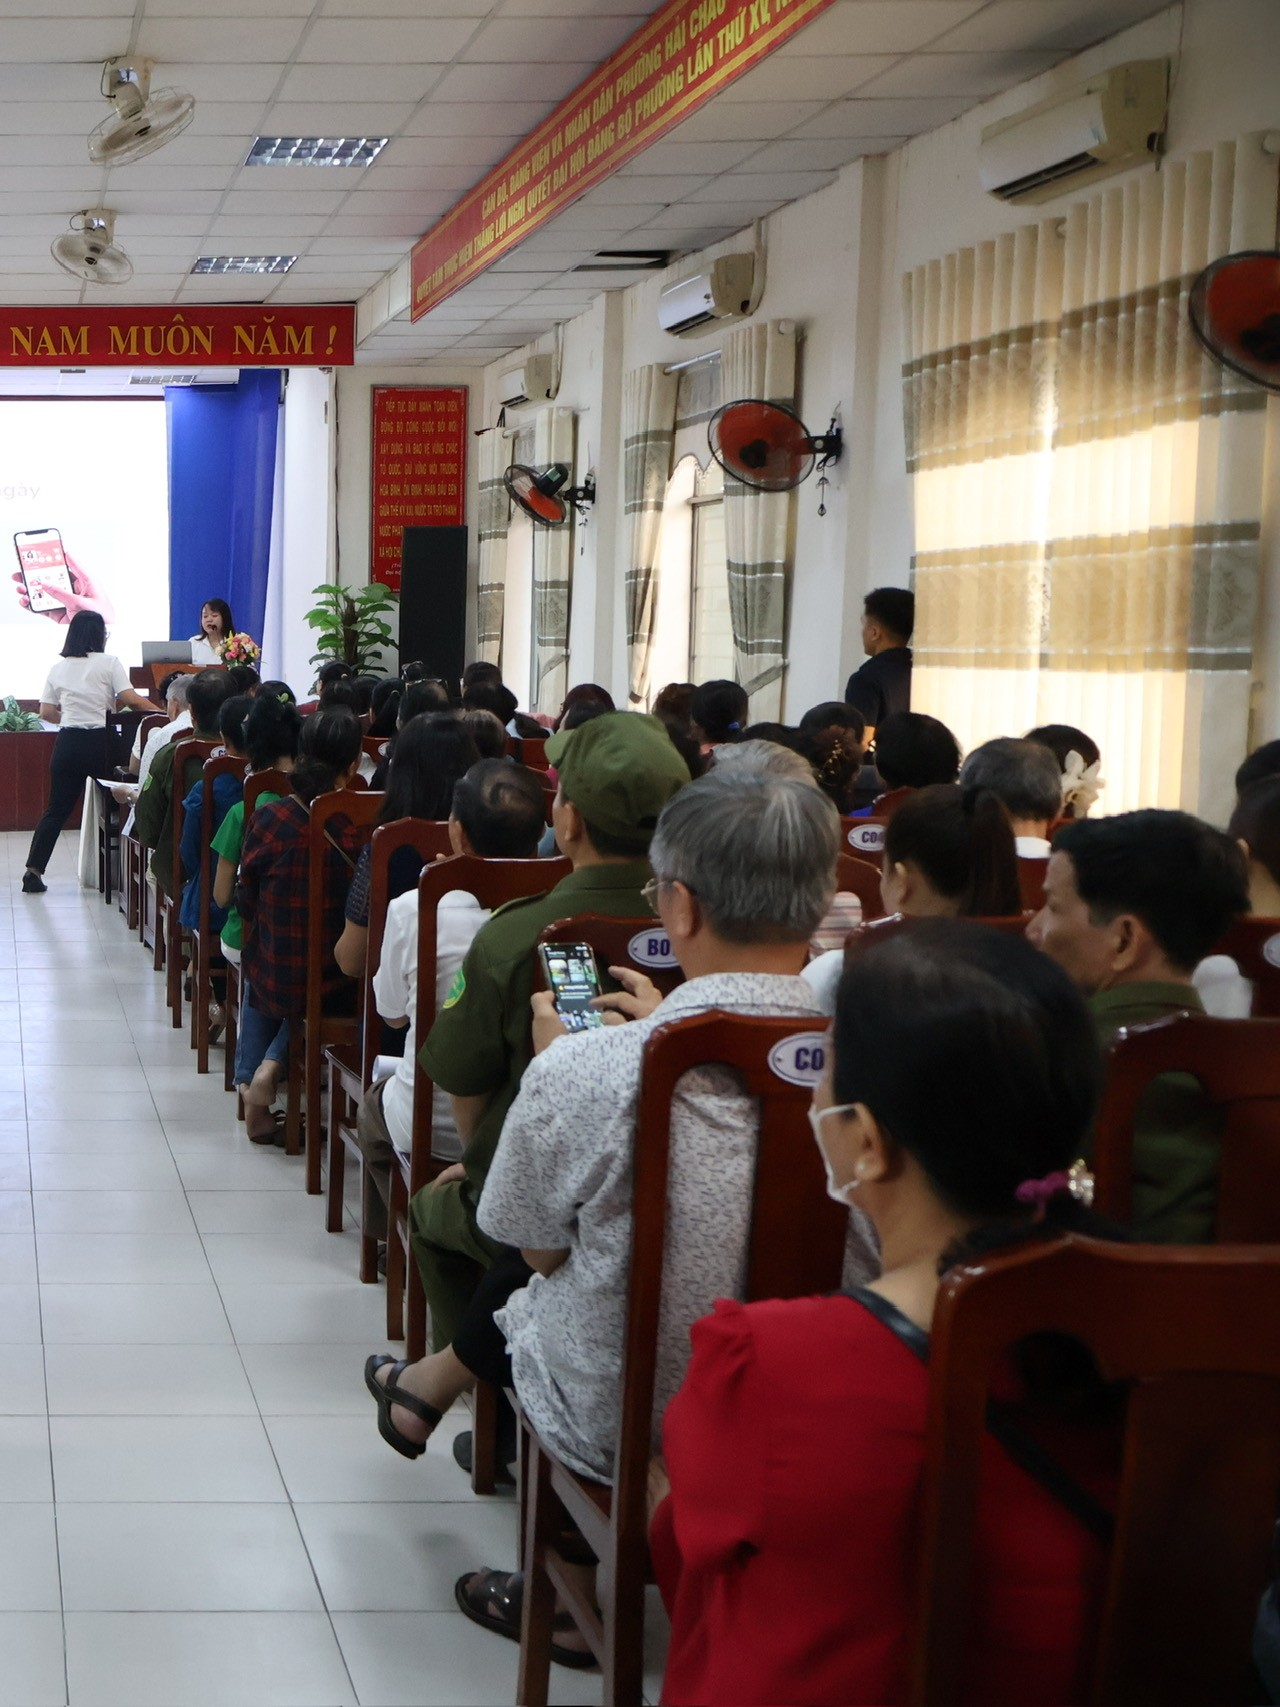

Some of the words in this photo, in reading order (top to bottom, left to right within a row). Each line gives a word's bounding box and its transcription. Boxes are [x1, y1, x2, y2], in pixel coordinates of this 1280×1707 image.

[616, 43, 661, 103] PHƯỜNG
[635, 64, 684, 126] PHƯỜNG
[687, 37, 714, 84] LẦN
[717, 6, 747, 59] THỨ
[10, 326, 90, 356] NAM
[107, 315, 214, 355] MUÔN
[233, 315, 315, 356] NĂM
[325, 325, 337, 355] !
[647, 938, 671, 956] B0
[795, 1047, 825, 1071] C0
